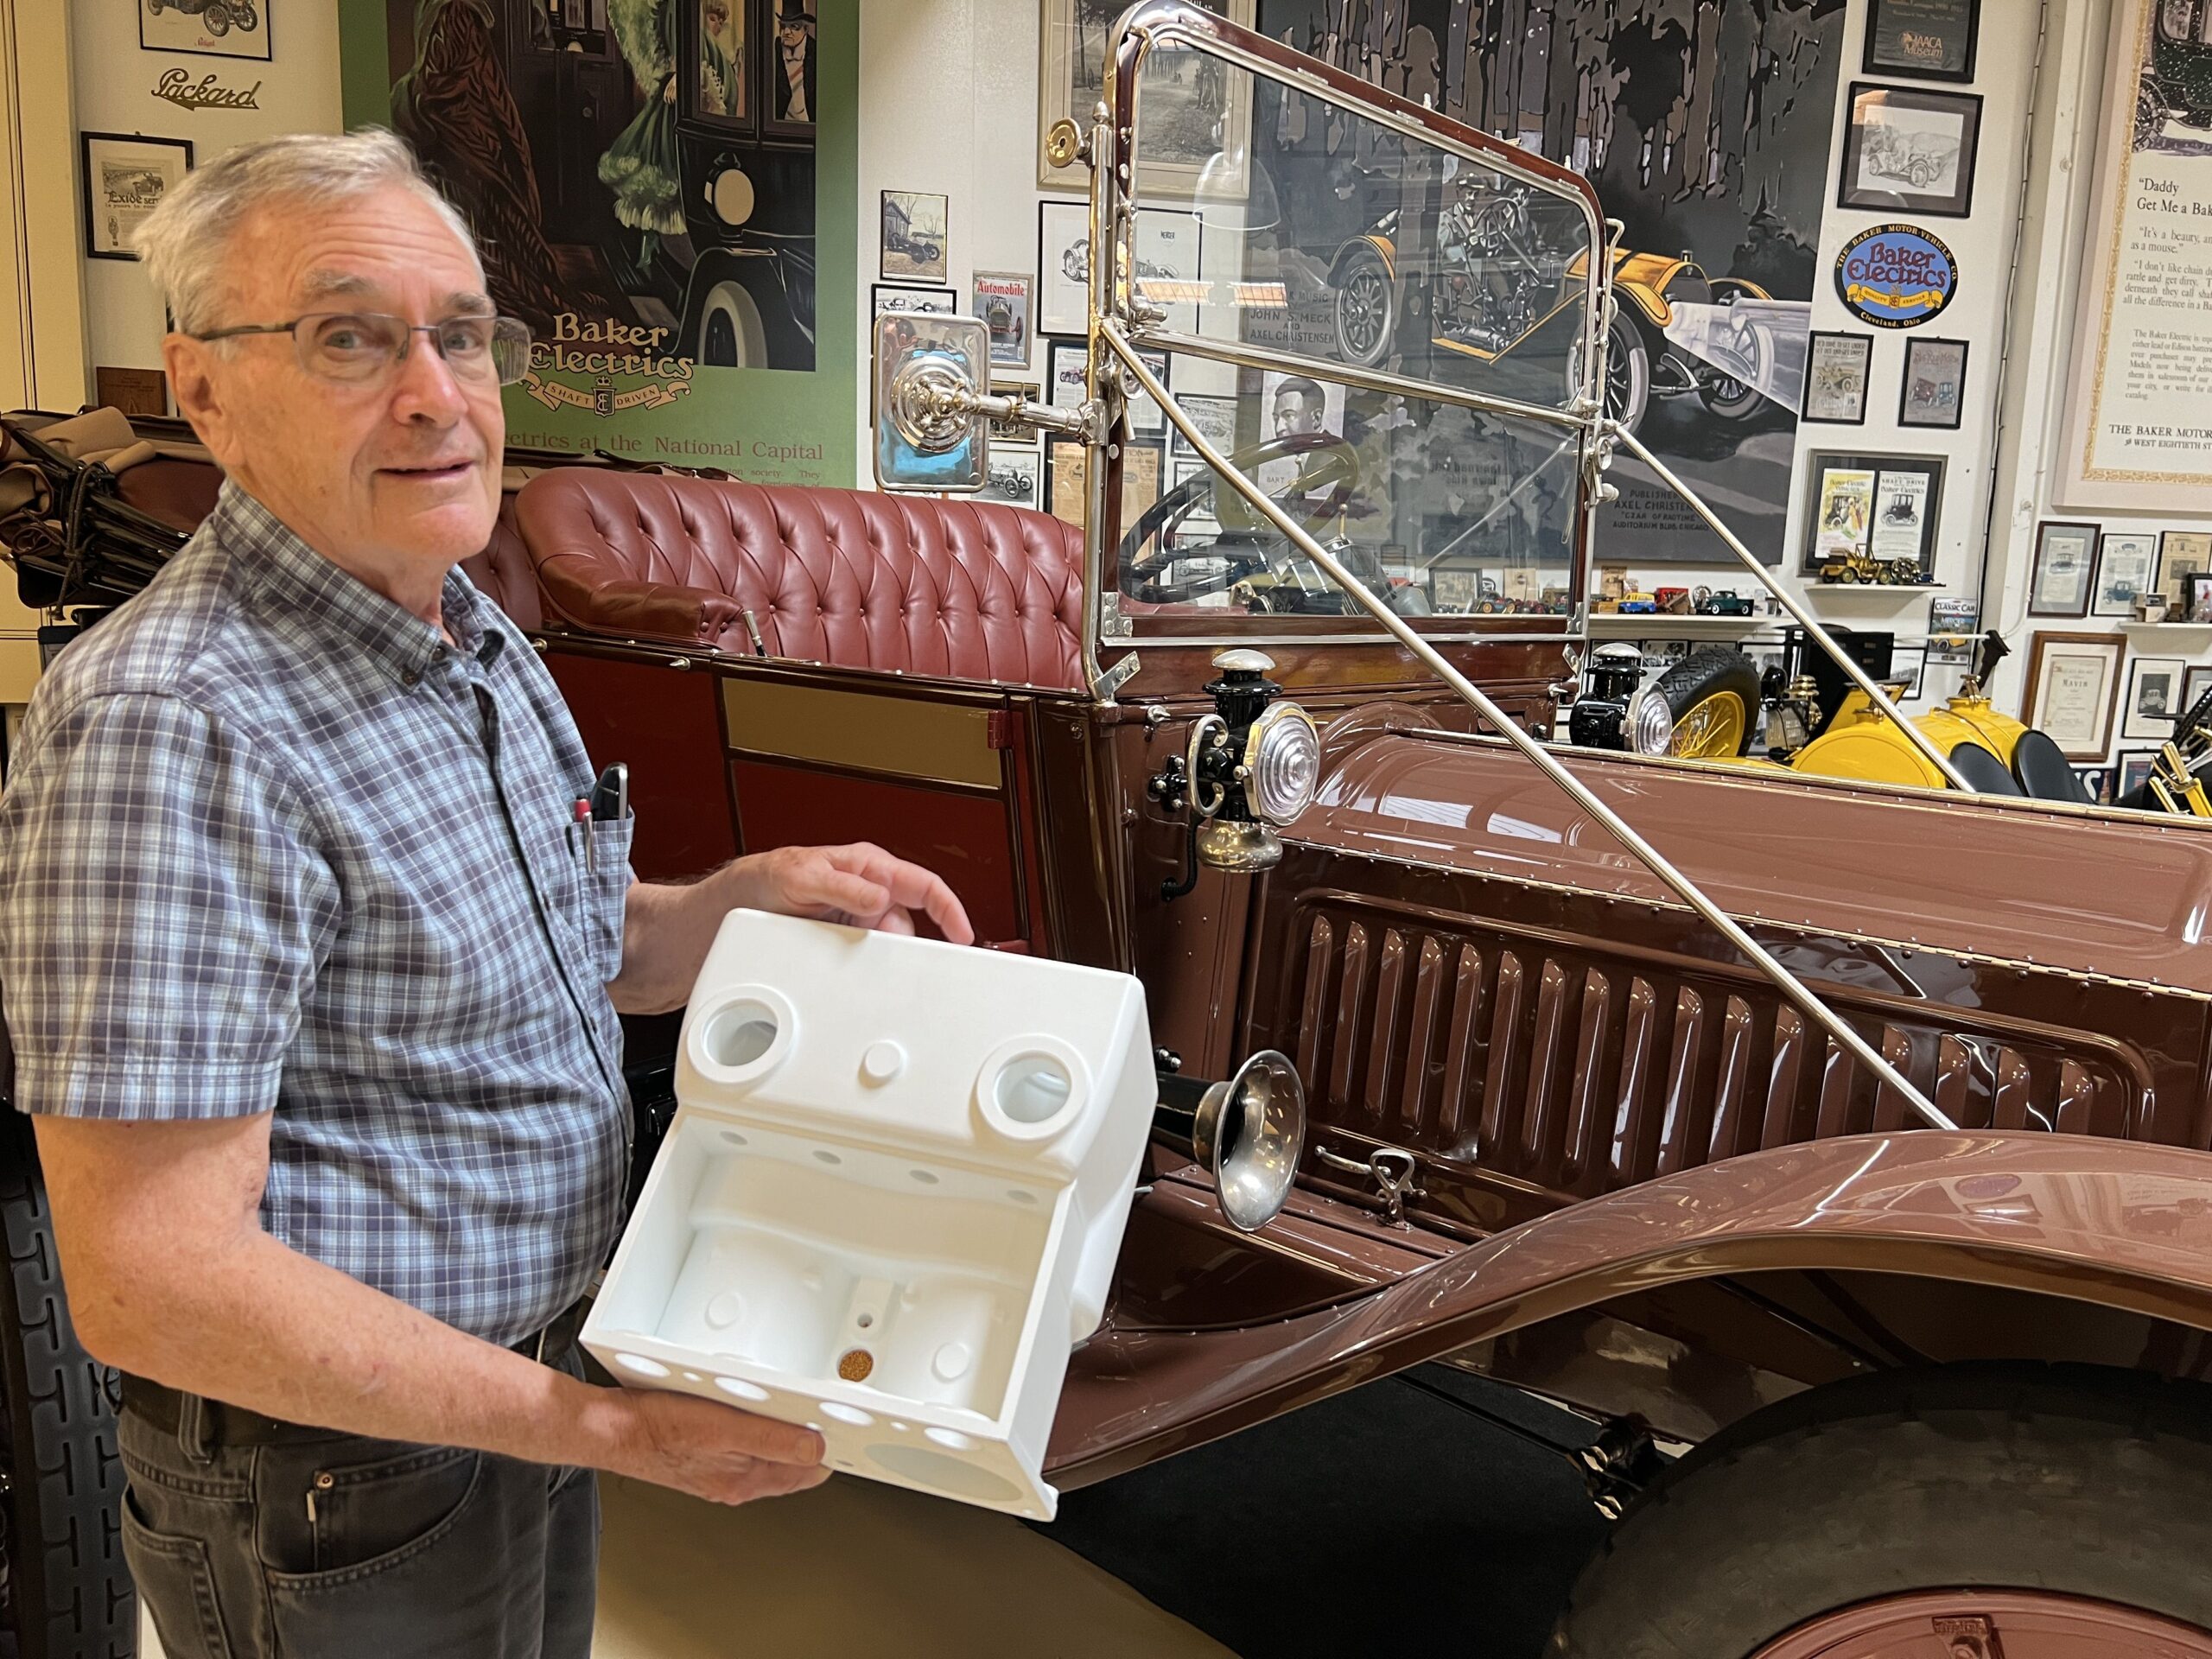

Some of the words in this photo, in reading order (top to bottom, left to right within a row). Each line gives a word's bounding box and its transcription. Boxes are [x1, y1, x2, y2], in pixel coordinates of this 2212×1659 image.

[1904, 44, 1943, 58] Museum
[151, 68, 262, 111] Packard
[2139, 178, 2179, 196] “Daddy
[107, 190, 143, 204] Exide
[2137, 197, 2157, 211] Get
[2161, 199, 2177, 213] Me
[2181, 206, 2187, 214] a
[2171, 230, 2200, 245] beauty,
[1837, 247, 1849, 268] THE
[1853, 226, 1882, 246] BAKER
[1870, 242, 1936, 268] Baker
[1847, 257, 1946, 288] Electrics
[2145, 260, 2164, 271] don't
[2167, 263, 2182, 273] like
[2183, 264, 2203, 275] chain
[2126, 272, 2145, 282] rattle
[2165, 276, 2177, 285] get
[2179, 276, 2198, 286] dirty.
[977, 281, 1025, 296] Automobile
[2125, 283, 2157, 294] derneath
[2162, 286, 2178, 297] they
[2181, 286, 2194, 297] call
[1299, 292, 1329, 302] MUSIC
[2123, 294, 2133, 304] all
[2134, 296, 2146, 305] the
[2148, 296, 2184, 308] difference
[2188, 299, 2195, 309] in
[1249, 310, 1280, 321] JOHN
[1300, 313, 1331, 324] MECK
[1903, 318, 1921, 327] Ohio
[551, 313, 669, 347] Baker
[1249, 330, 1274, 340] AXEL
[1275, 332, 1335, 344] CHRISTENSEN
[2133, 328, 2147, 338] The
[2149, 330, 2167, 339] Baker
[2169, 332, 2191, 340] Electric
[2151, 340, 2164, 349] lead
[2171, 342, 2191, 351] Edison
[529, 341, 694, 380] Electrics
[2150, 352, 2178, 361] purchaser
[2131, 359, 2152, 369] Models
[2175, 364, 2191, 372] being
[2128, 370, 2145, 378] them
[550, 385, 589, 405] SHAFT
[616, 389, 656, 405] DRIVEN
[2108, 423, 2132, 434] THE
[2137, 426, 2172, 435] BAKER
[2176, 427, 2212, 438] MOTOR
[581, 435, 600, 449] at
[611, 436, 641, 453] the
[655, 437, 741, 457] National
[752, 442, 823, 463] Capital
[2134, 439, 2157, 448] WEST
[2158, 441, 2200, 449] EIGHTIETH
[799, 470, 821, 480] They
[1614, 501, 1641, 510] AXEL
[1645, 501, 1694, 512] CHRISTEN
[1612, 521, 1657, 530] AUDITORIUM
[1936, 602, 1961, 612] CLASSIC
[1961, 603, 1975, 612] CAR
